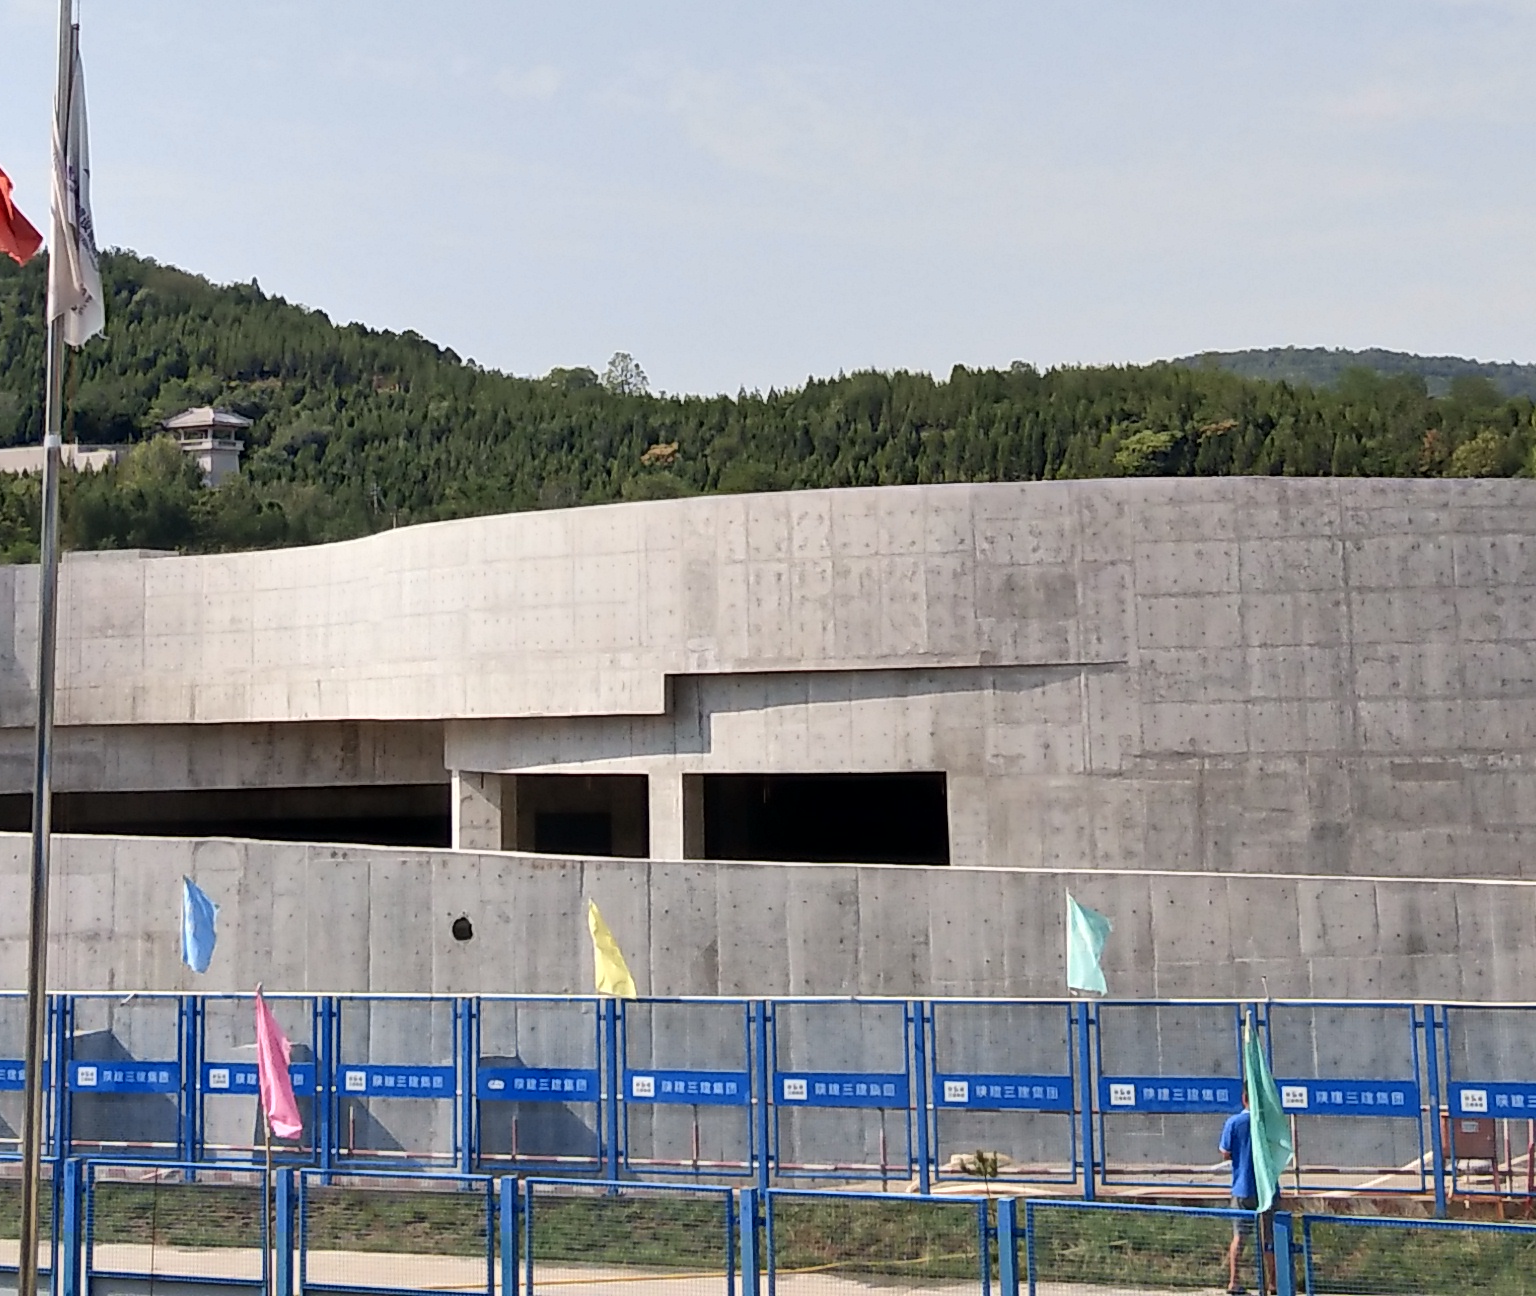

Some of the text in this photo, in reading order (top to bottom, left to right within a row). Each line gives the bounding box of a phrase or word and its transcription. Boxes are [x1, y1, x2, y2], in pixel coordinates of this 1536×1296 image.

[976, 1085, 1058, 1100] 陕建三建集团
[1144, 1088, 1229, 1102] 陕建三建集团
[1316, 1091, 1404, 1105] 陕建三建集团
